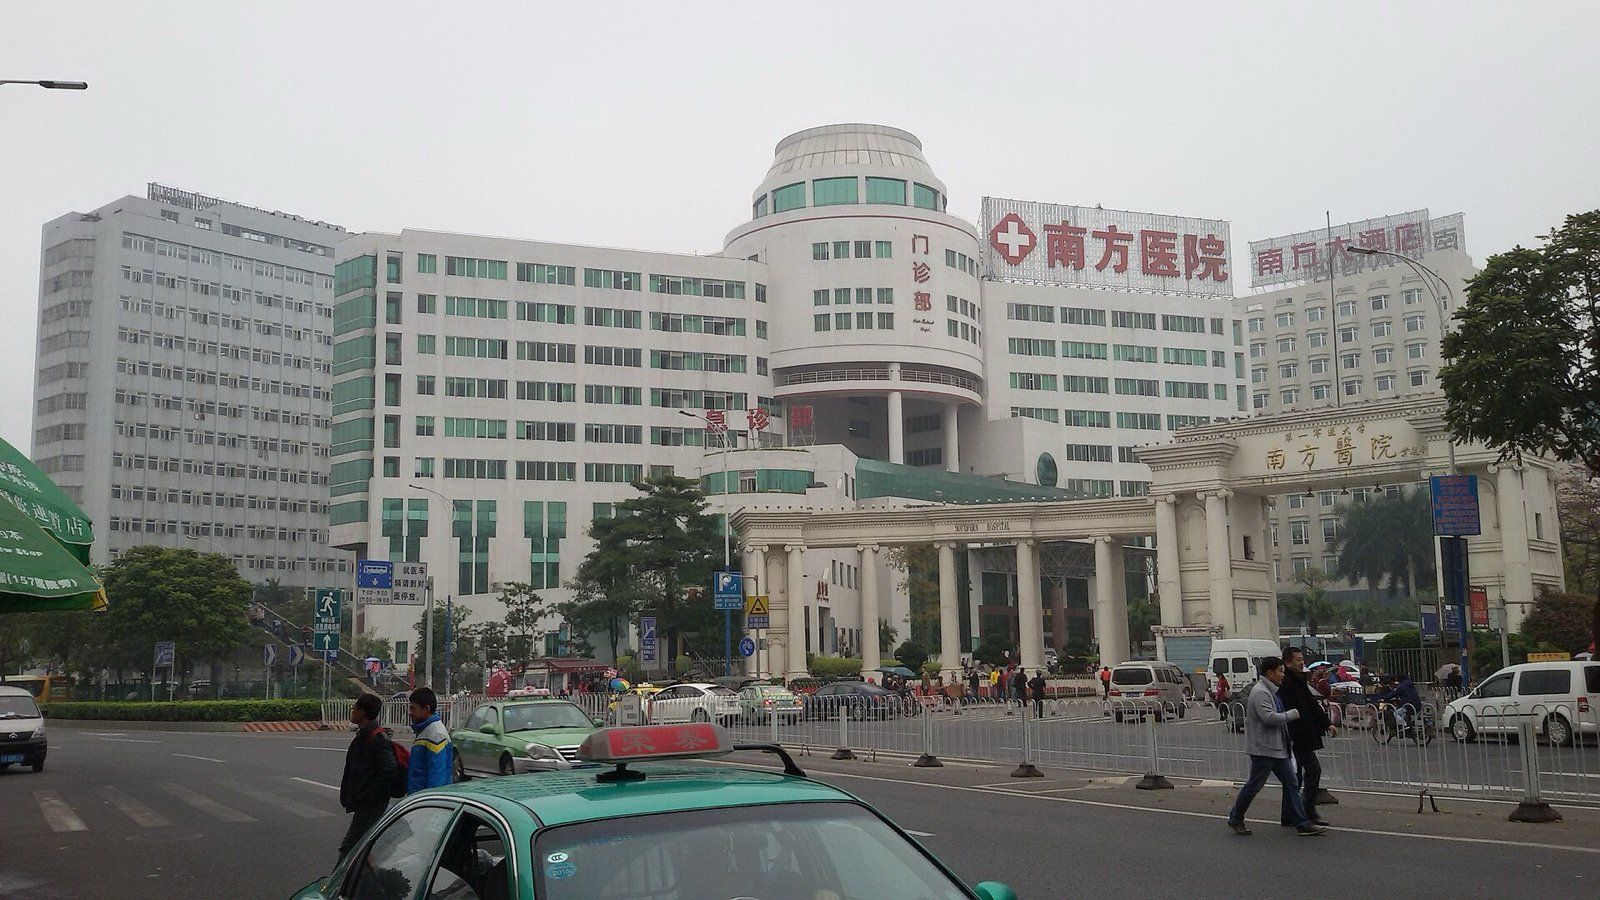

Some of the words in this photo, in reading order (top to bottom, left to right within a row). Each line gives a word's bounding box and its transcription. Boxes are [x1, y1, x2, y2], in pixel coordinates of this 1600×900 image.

[911, 233, 932, 311] 门诊部
[1043, 219, 1229, 282] 南方医院
